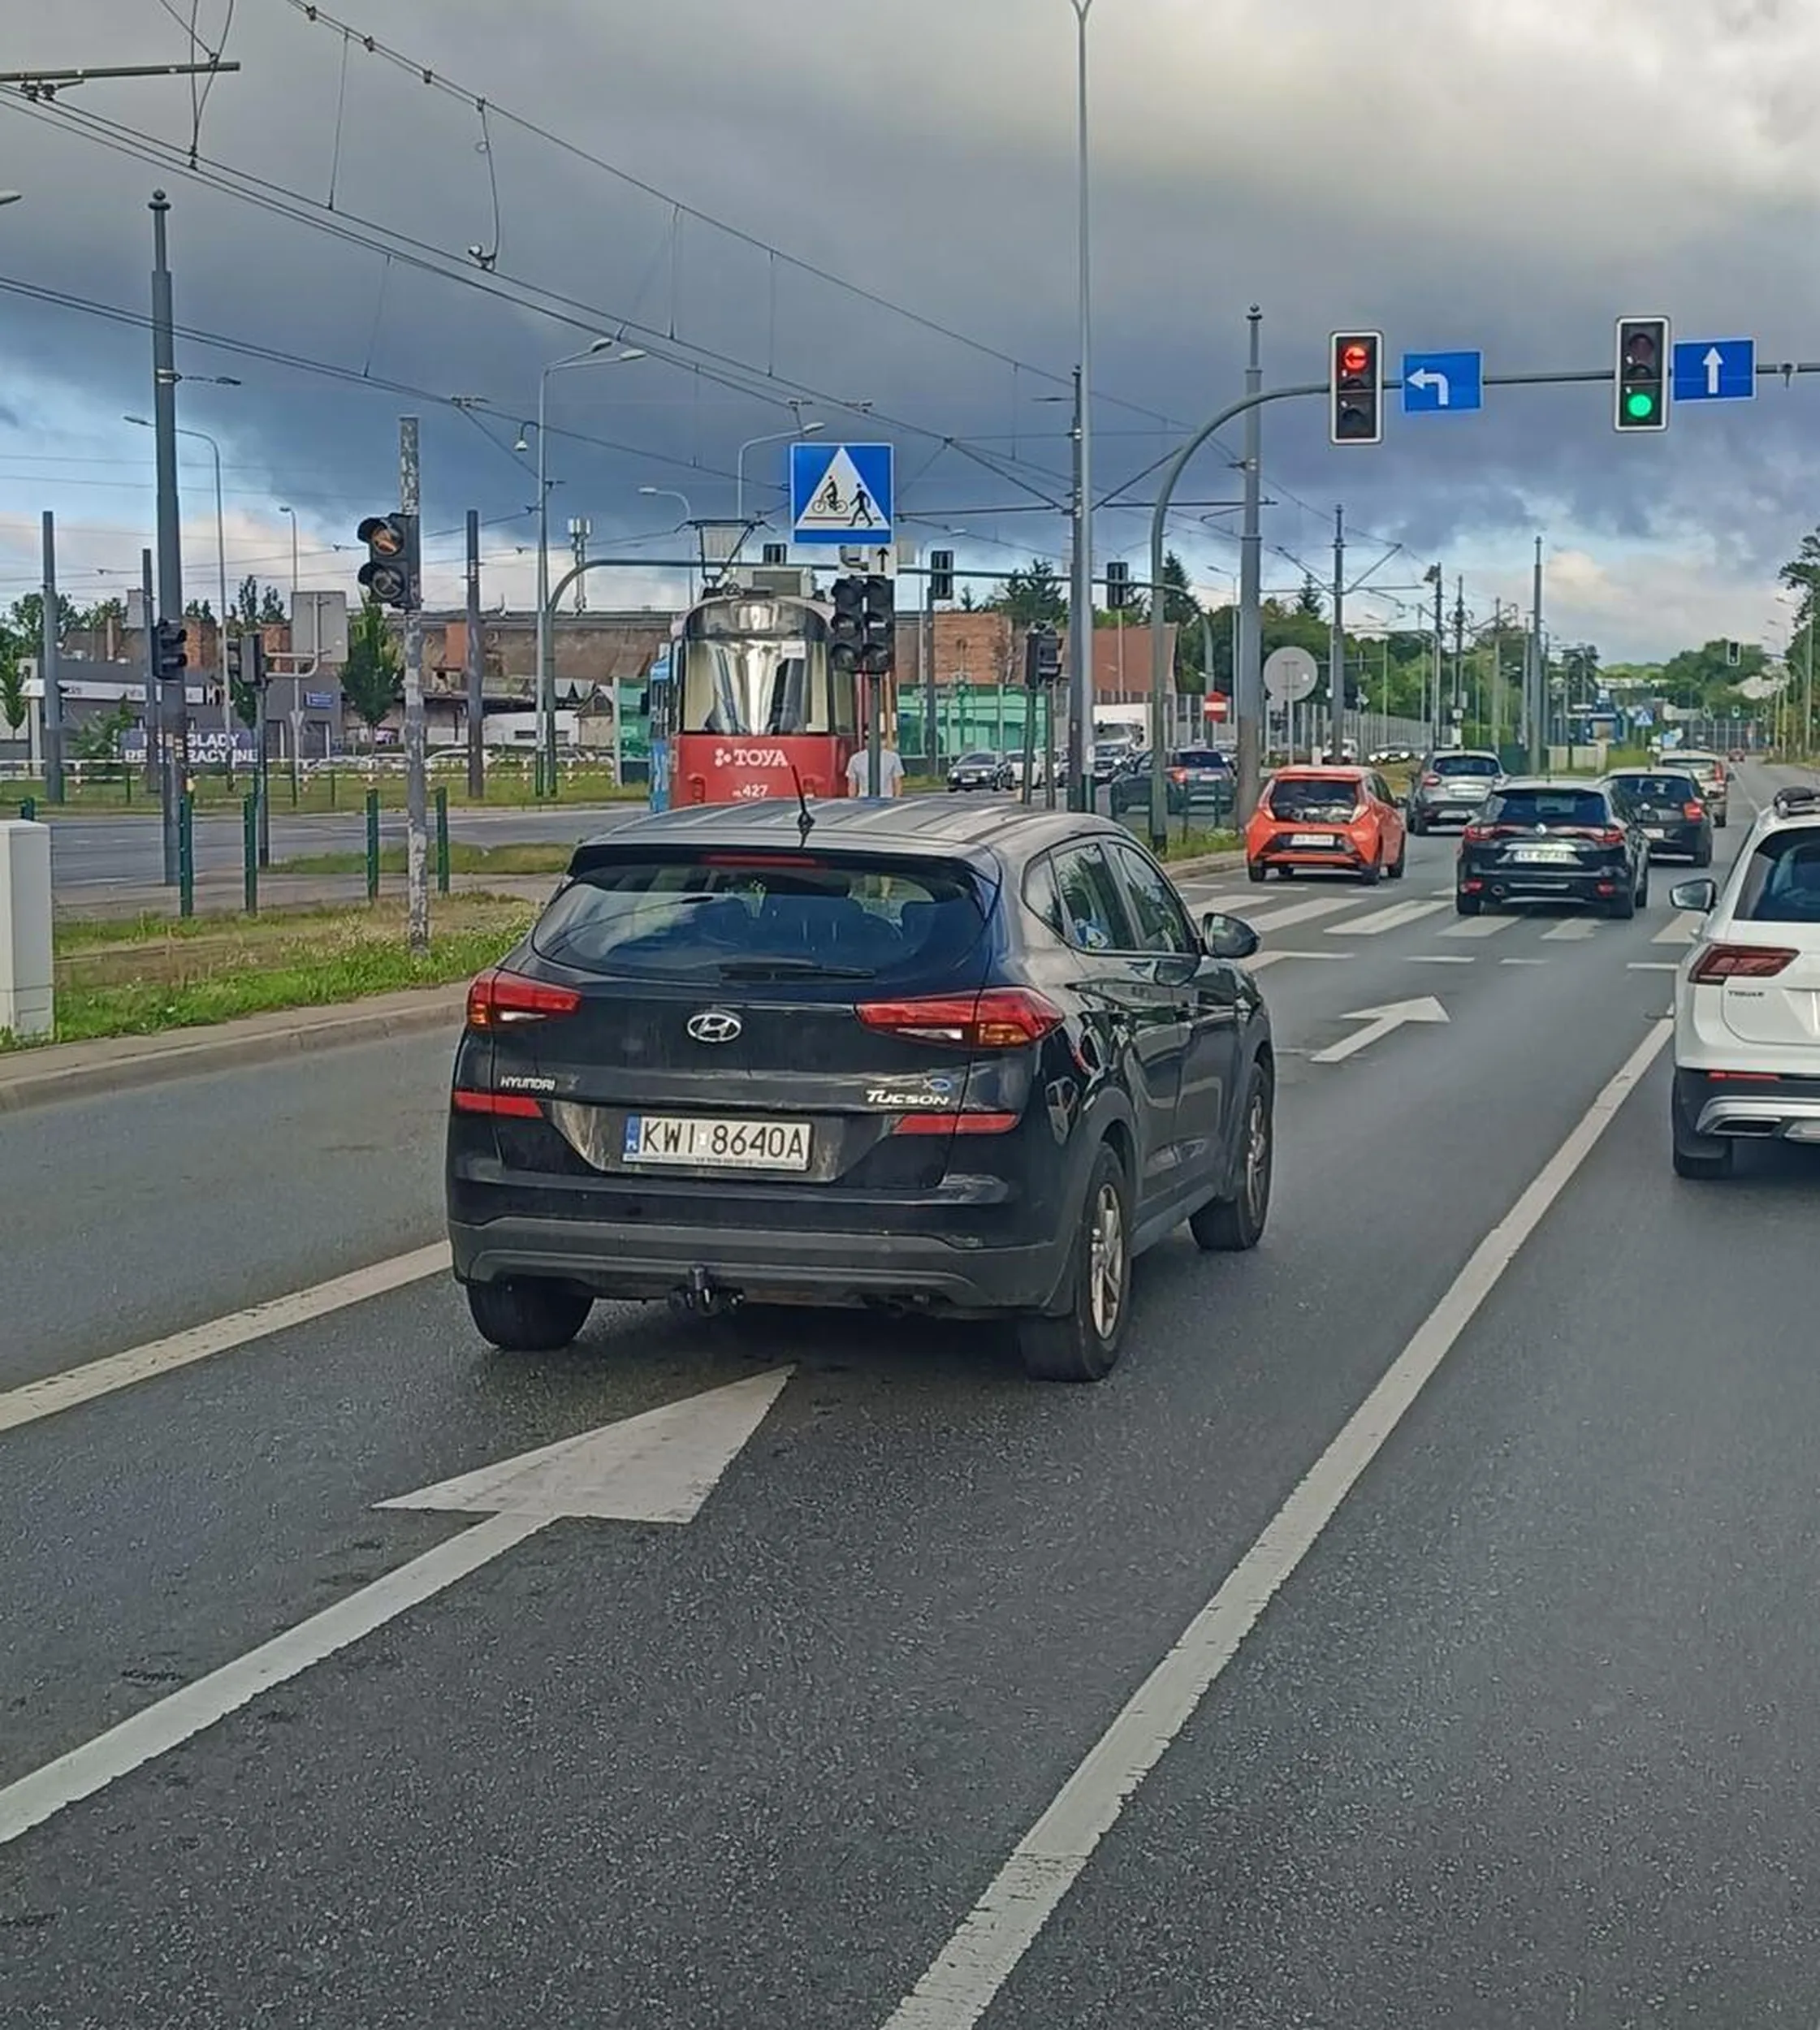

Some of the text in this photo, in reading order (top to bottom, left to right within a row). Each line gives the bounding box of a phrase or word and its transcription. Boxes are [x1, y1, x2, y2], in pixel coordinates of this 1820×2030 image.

[733, 748, 789, 767] TOYA
[742, 784, 768, 797] 427
[500, 1075, 556, 1091] HYUNDAI
[866, 1090, 949, 1105] TUCSON
[642, 1121, 804, 1159] KWI 8640A
